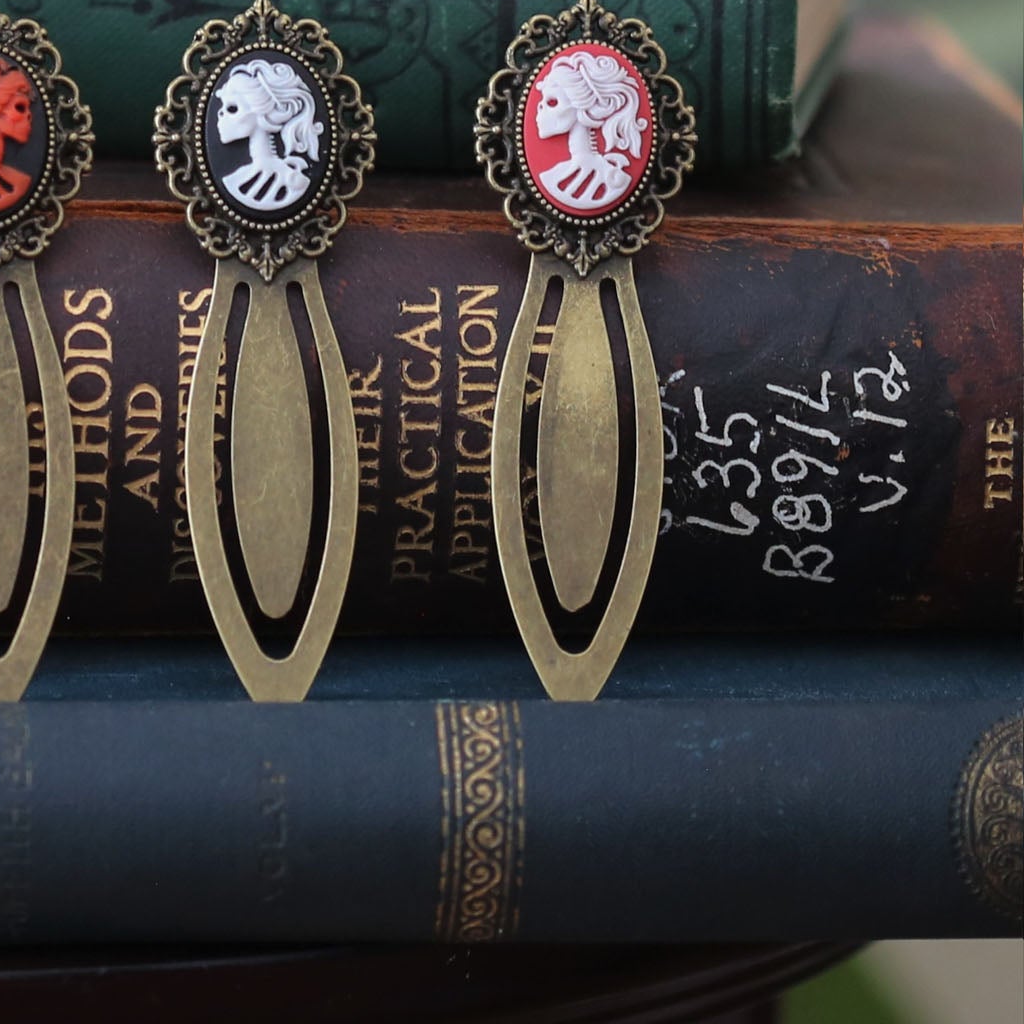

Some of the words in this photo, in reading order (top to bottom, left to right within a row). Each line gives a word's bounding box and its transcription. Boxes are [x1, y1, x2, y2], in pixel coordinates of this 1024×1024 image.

[64, 287, 113, 582] METHODS
[123, 382, 163, 514] AND
[391, 286, 442, 583] PRACTICAL
[448, 283, 499, 583] APPLICATION
[686, 386, 761, 535] 635
[984, 417, 1015, 510] THE
